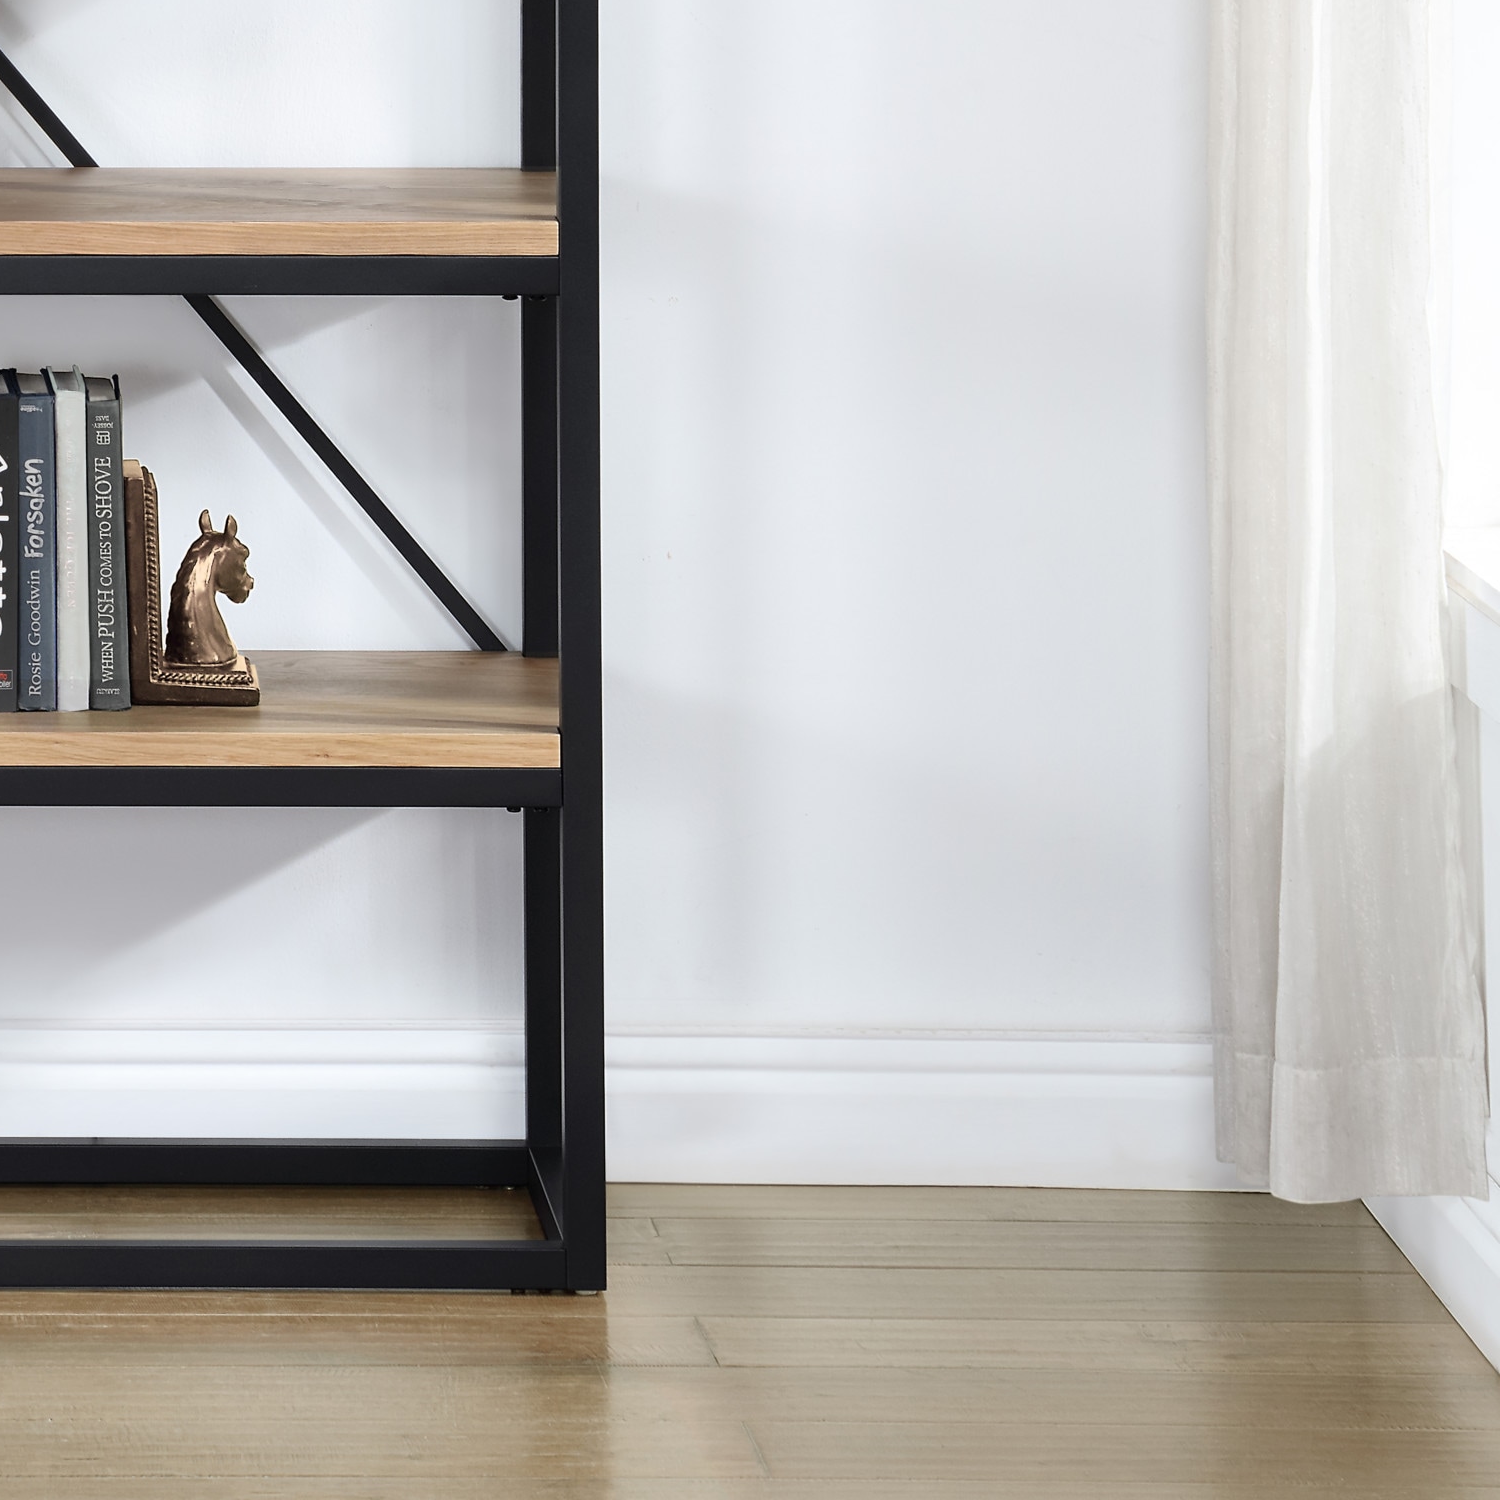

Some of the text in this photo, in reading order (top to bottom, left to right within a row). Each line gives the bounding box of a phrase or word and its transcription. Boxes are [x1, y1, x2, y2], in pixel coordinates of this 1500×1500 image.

[18, 458, 45, 696] Rosie Goodwin Forsaken
[94, 456, 115, 683] WHEN PUSH COMES TO SHOVE
